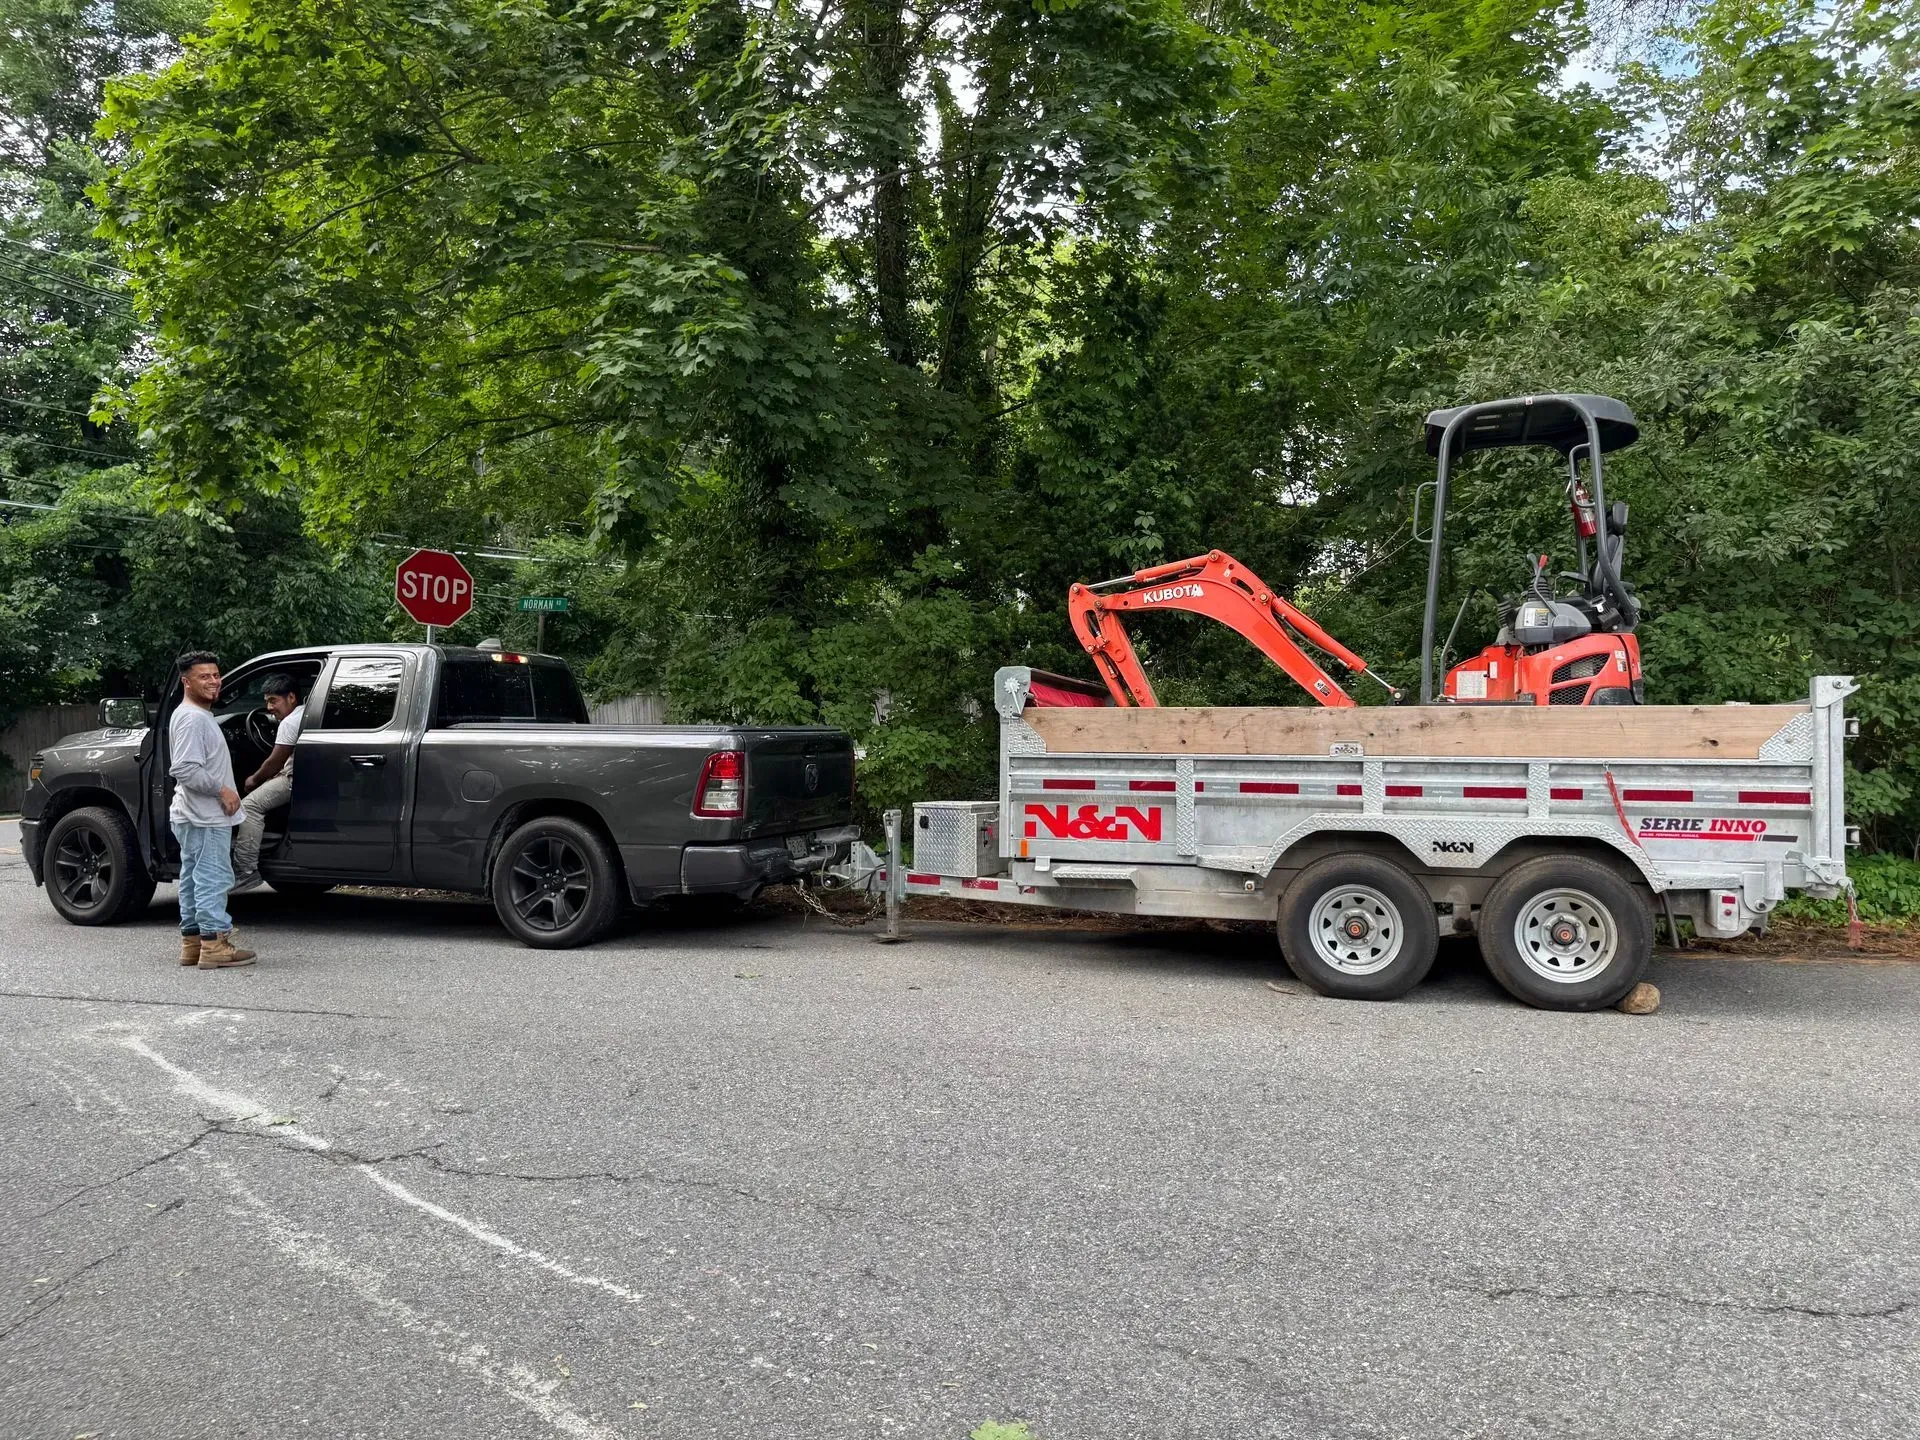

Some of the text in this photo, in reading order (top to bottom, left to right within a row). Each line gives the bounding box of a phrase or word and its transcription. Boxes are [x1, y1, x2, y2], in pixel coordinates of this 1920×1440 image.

[401, 570, 468, 605] STOP
[1143, 583, 1204, 604] KUBOTA
[523, 599, 554, 609] NORMAN
[1024, 804, 1162, 841] N&N
[1639, 817, 1767, 833] SERIE INNO
[1432, 841, 1474, 853] N&N
